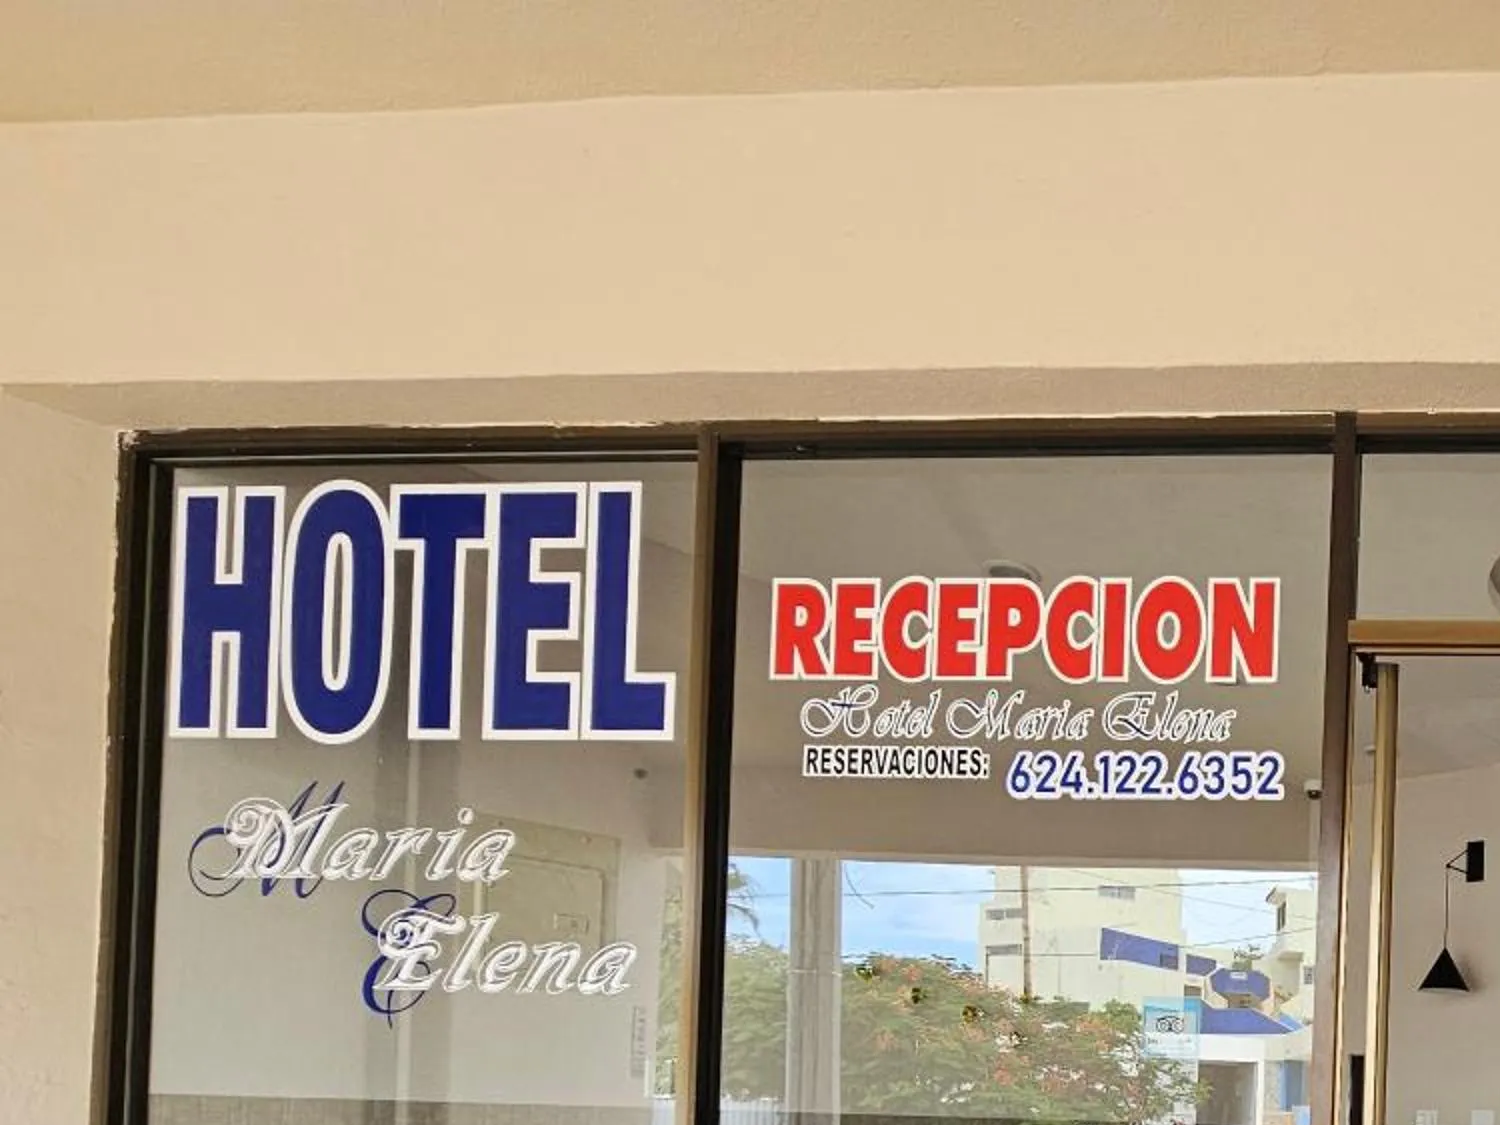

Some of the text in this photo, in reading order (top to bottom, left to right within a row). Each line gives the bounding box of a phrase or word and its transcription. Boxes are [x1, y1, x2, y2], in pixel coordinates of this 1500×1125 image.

[169, 479, 676, 744] HOTEL
[769, 575, 1281, 684] RECEPCION
[800, 684, 1237, 743] Hotel Maria Elena
[802, 745, 1284, 799] RESERVACIONES: 624.122.6352
[188, 780, 516, 898] Maria
[361, 889, 637, 1028] Elena
